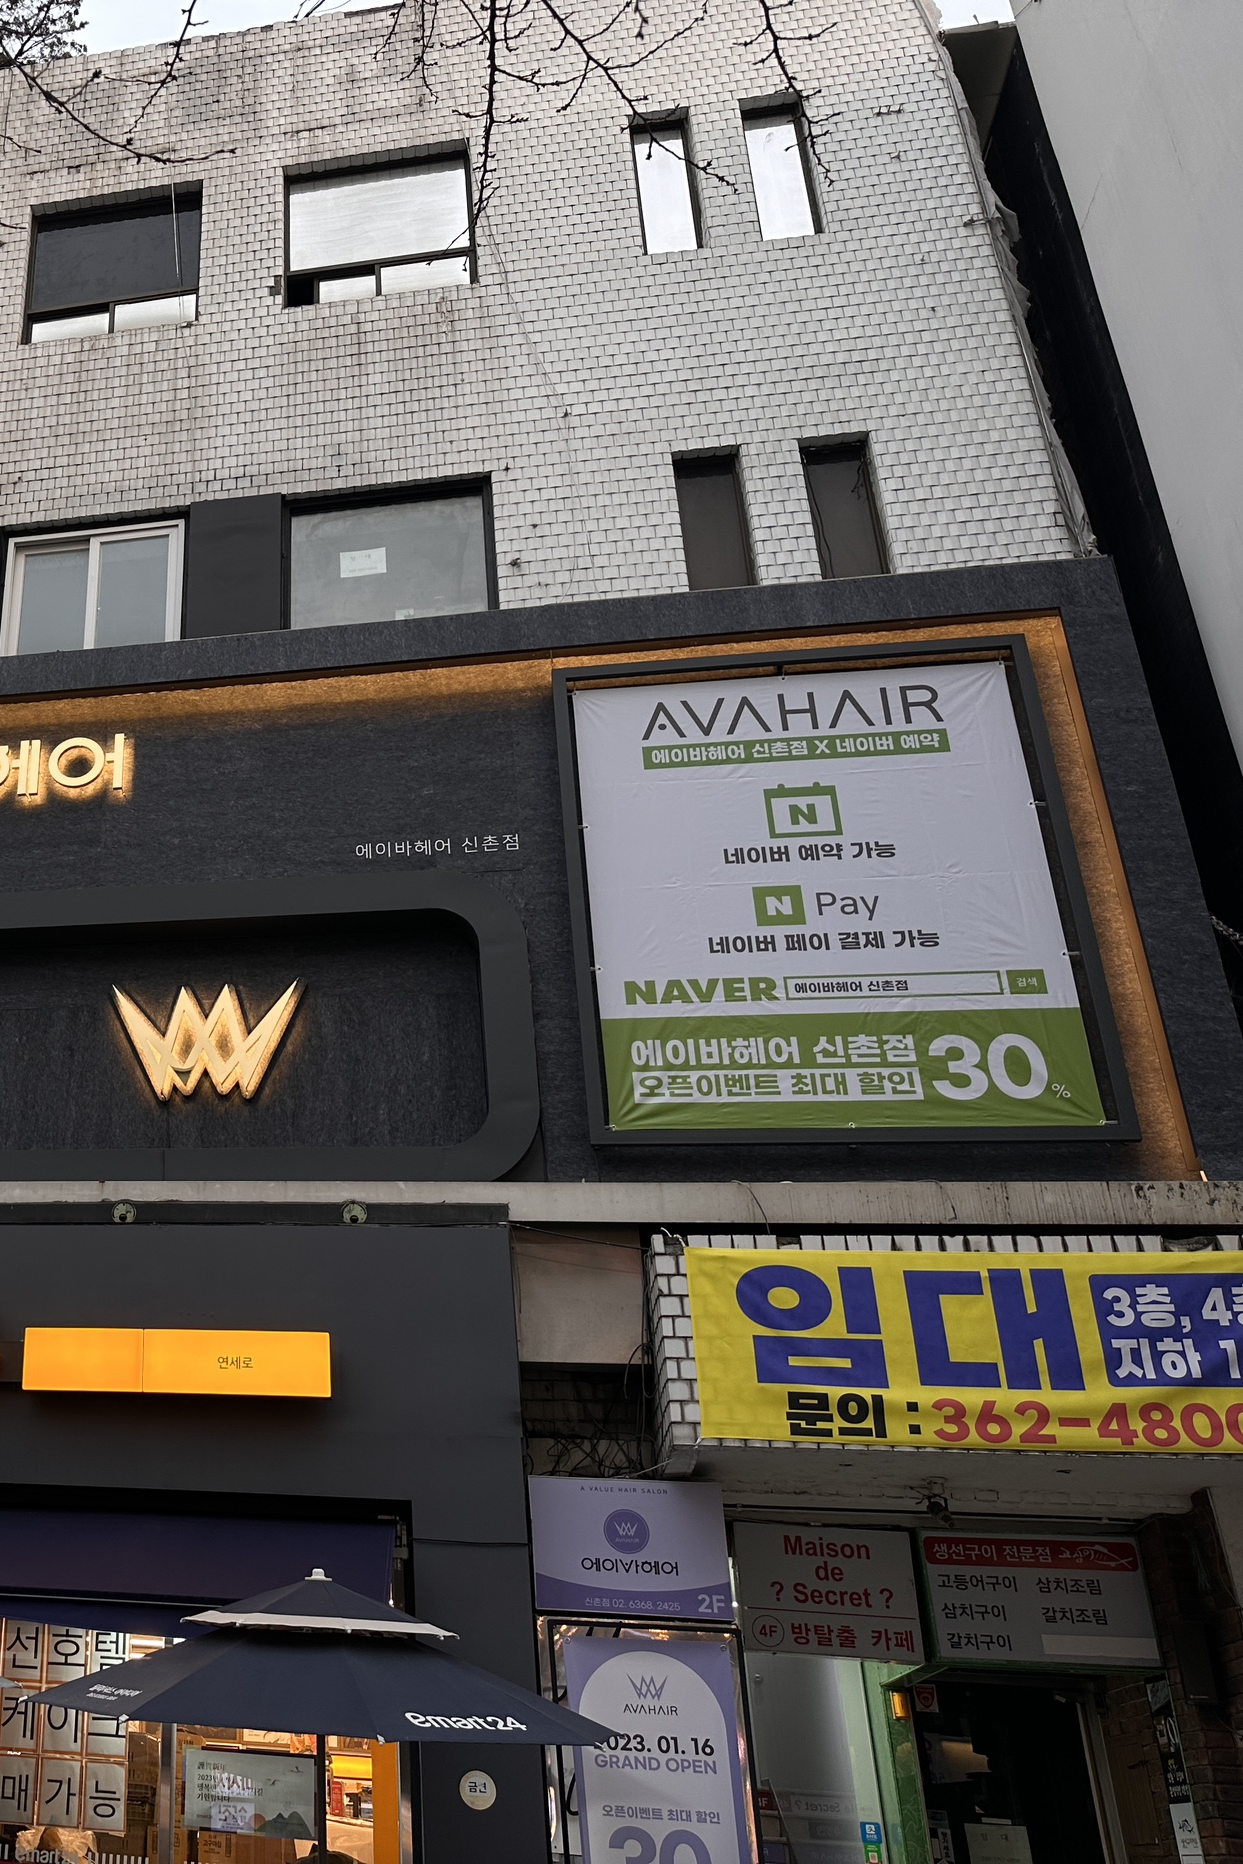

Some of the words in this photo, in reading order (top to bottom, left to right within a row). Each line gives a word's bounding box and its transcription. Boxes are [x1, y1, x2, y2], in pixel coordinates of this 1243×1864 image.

[642, 684, 944, 740] AVAHAIR
[650, 741, 746, 764] 에이바헤어
[751, 738, 809, 759] 신촌점
[814, 739, 831, 754] X
[836, 735, 895, 754] 네이버
[900, 732, 940, 751] 예약
[355, 838, 452, 860] 에이바헤어
[461, 833, 520, 854] 신촌점
[723, 846, 791, 866] 네이버
[798, 843, 844, 862] 예약
[851, 841, 897, 860] 가능
[814, 891, 880, 921] Pay
[707, 933, 777, 955] 네이버
[784, 932, 831, 952] 페이
[837, 930, 886, 951] 결제
[892, 929, 940, 949] 가능
[623, 976, 782, 1006] NAVER
[793, 979, 863, 995] 에이바헤어
[866, 978, 910, 994] 신촌점
[1015, 975, 1038, 989] 검색
[630, 1035, 802, 1068] 에이바헤어
[811, 1033, 917, 1064] 신촌점
[927, 1033, 1050, 1101] 30
[637, 1072, 781, 1099] 오픈이벤트
[789, 1071, 848, 1098] 최대
[856, 1069, 918, 1097] 할인
[216, 1355, 254, 1370] 연세로
[1110, 1337, 1202, 1379] 지하
[786, 1392, 887, 1438] 문의
[783, 1534, 871, 1560] Maison
[933, 1543, 998, 1561] 생선구이
[1002, 1545, 1053, 1563] 전문점
[815, 1561, 844, 1582] de
[792, 1580, 873, 1609] Secret
[937, 1573, 1018, 1592] 고등어구이
[1035, 1576, 1103, 1595] 삼치조림
[585, 1596, 610, 1608] 신촌점
[656, 1601, 681, 1612] 2425
[697, 1593, 726, 1614] 2F
[941, 1602, 1008, 1622] 삼치구이
[1041, 1606, 1108, 1625] 갈치조림
[758, 1623, 779, 1639] 4F
[790, 1622, 858, 1649] 방탈출
[870, 1628, 916, 1654] 카페
[946, 1632, 1013, 1651] 갈치구이
[623, 1703, 679, 1716] AVAHAIR
[404, 1711, 527, 1732] emart24
[691, 1737, 715, 1757] 16
[594, 1753, 660, 1772] GRAND
[665, 1757, 718, 1775] OPEN
[467, 1781, 488, 1794] 금연
[602, 1804, 664, 1821] 오픈이벤트
[667, 1806, 692, 1823] 최대
[695, 1809, 721, 1825] 할인
